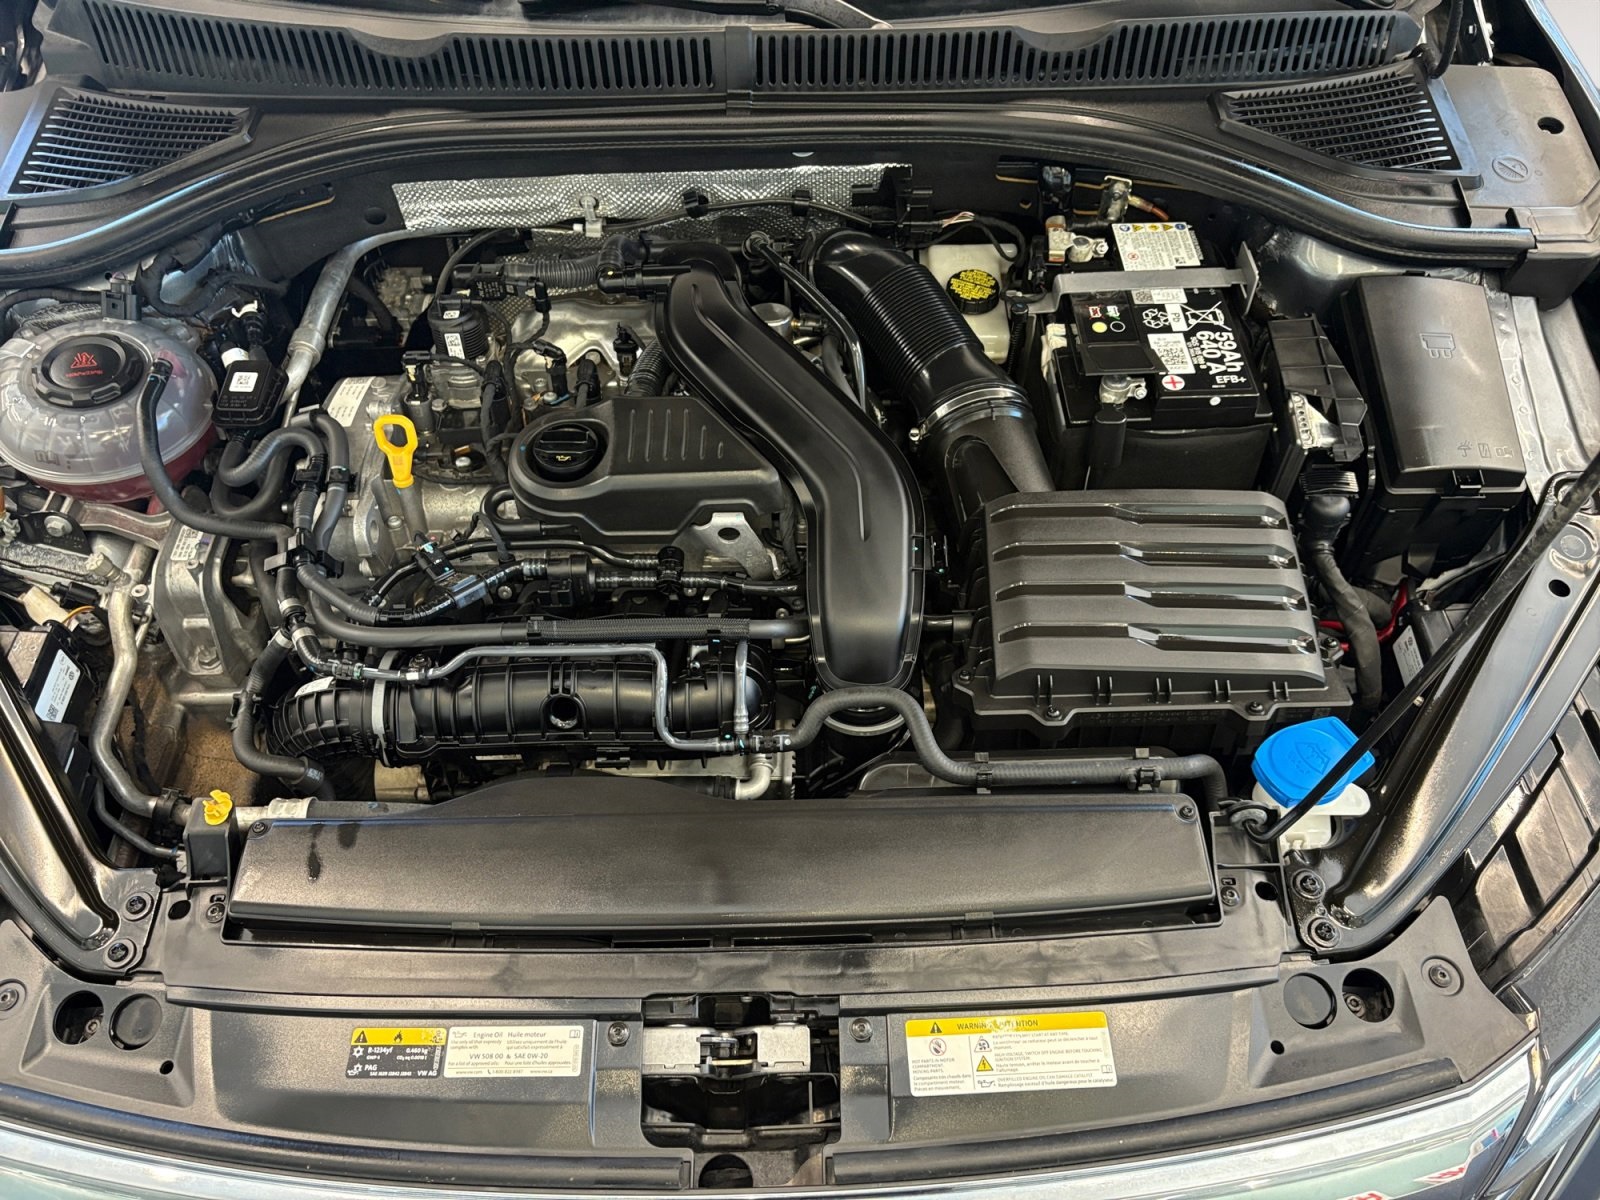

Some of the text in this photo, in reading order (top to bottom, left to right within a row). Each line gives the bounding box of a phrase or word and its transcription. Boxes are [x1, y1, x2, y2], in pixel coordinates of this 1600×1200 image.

[1170, 312, 1181, 322] Pb
[1196, 331, 1221, 358] 640
[1214, 331, 1244, 372] 59Ah
[1206, 362, 1227, 375] A
[1215, 375, 1247, 384] EFB+
[957, 1019, 1039, 1031] WARNIN TTNTION
[368, 1046, 394, 1055] R-1234yf
[422, 1047, 429, 1055] kg
